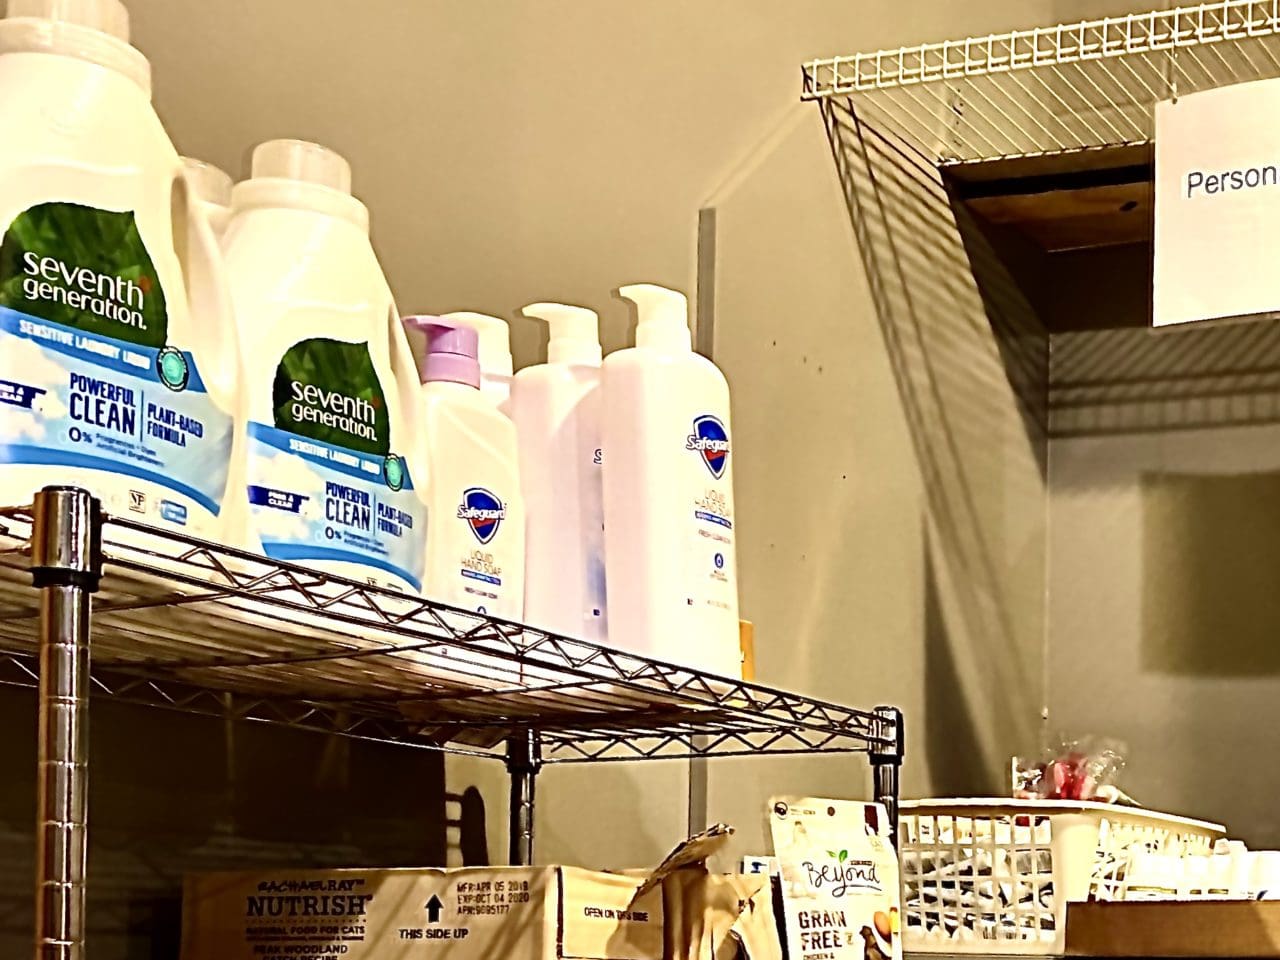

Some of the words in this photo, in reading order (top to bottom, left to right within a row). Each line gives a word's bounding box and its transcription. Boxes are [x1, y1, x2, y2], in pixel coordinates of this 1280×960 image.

[23, 251, 144, 310] seventh
[70, 371, 137, 408] POWERFUL
[290, 380, 376, 425] seventh
[69, 392, 136, 437] CLEAN
[147, 402, 204, 439] PLANT-BASED
[68, 426, 93, 444] 0%
[147, 420, 187, 448] FORMULA
[325, 480, 371, 508] POWERFUL
[325, 497, 371, 532] CLEAN
[457, 502, 507, 522] Safeguard
[325, 526, 343, 541] 0%
[494, 881, 505, 892] 05
[801, 860, 883, 898] Beyond
[494, 892, 505, 904] 04
[508, 891, 530, 904] 2020
[584, 906, 603, 918] OPEN
[604, 909, 615, 919] ON
[798, 909, 848, 930] GRAIN
[291, 925, 318, 935] FOOD
[320, 925, 339, 935] FOR
[342, 925, 366, 935] CATS
[399, 928, 424, 940] THIS
[425, 928, 452, 940] SIDE
[453, 928, 470, 940] UP
[285, 944, 349, 955] WOODLAND
[800, 930, 844, 952] FREE
